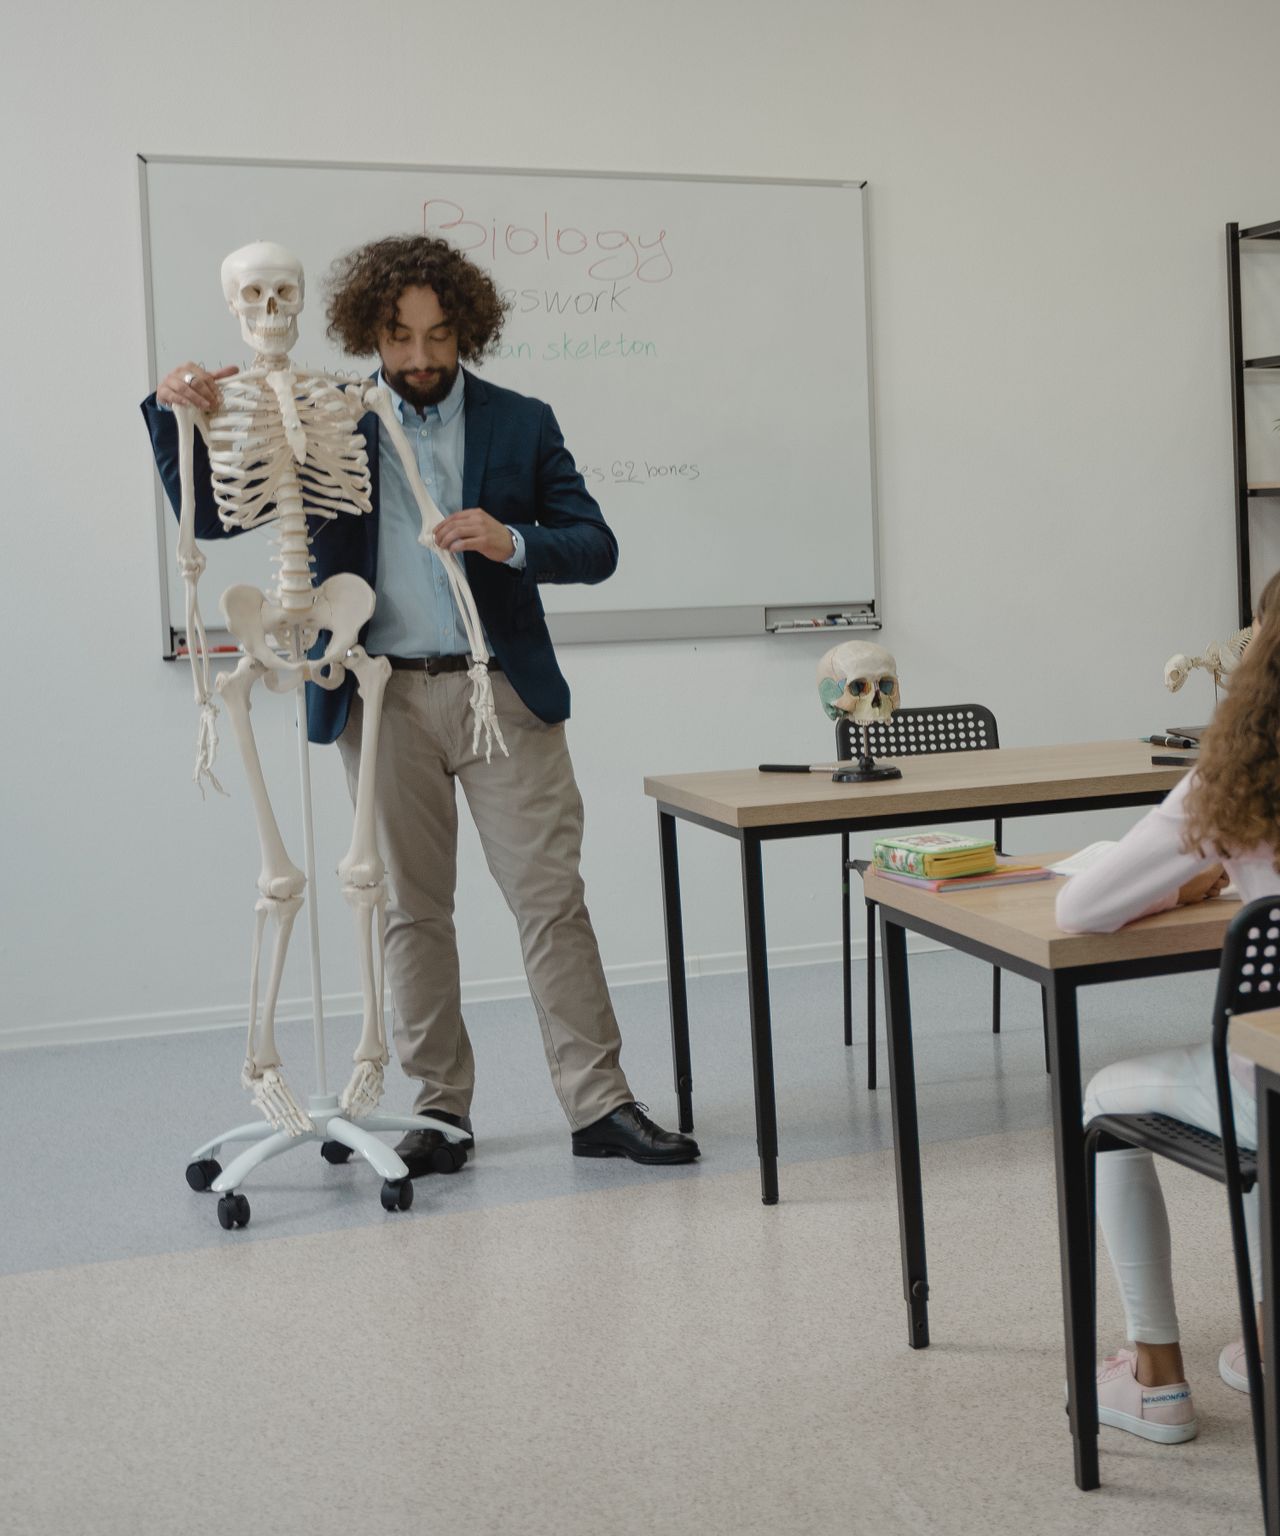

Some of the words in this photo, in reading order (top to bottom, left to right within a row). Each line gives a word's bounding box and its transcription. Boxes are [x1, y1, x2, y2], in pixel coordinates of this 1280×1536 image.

[423, 198, 673, 283] Biology
[542, 331, 658, 361] skeleton
[611, 460, 639, 481] 62
[644, 460, 700, 481] bones
